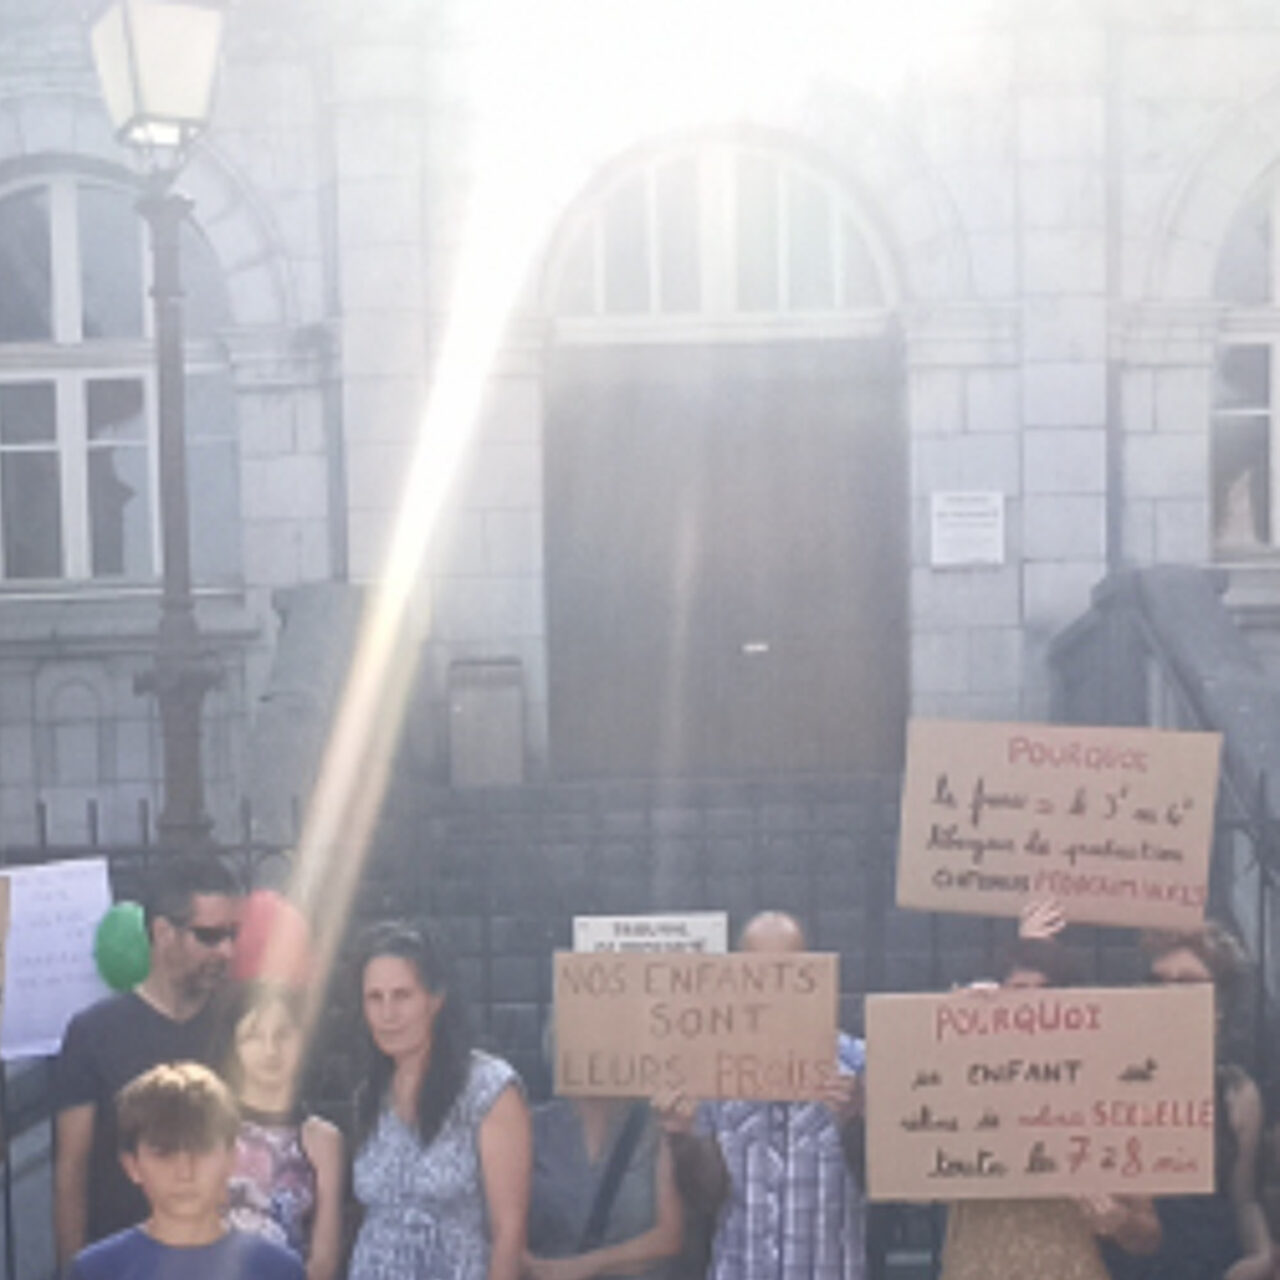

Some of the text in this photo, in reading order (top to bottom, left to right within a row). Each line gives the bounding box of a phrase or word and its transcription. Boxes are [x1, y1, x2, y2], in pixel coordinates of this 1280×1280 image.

[562, 961, 817, 996] NOS ENFANTS
[650, 1003, 769, 1039] SONT
[936, 1002, 1101, 1042] POURQUOI
[562, 1052, 686, 1089] LEURS
[968, 1060, 1082, 1085] ENFANT
[1069, 1136, 1090, 1174] 7
[1121, 1136, 1143, 1177] 8
